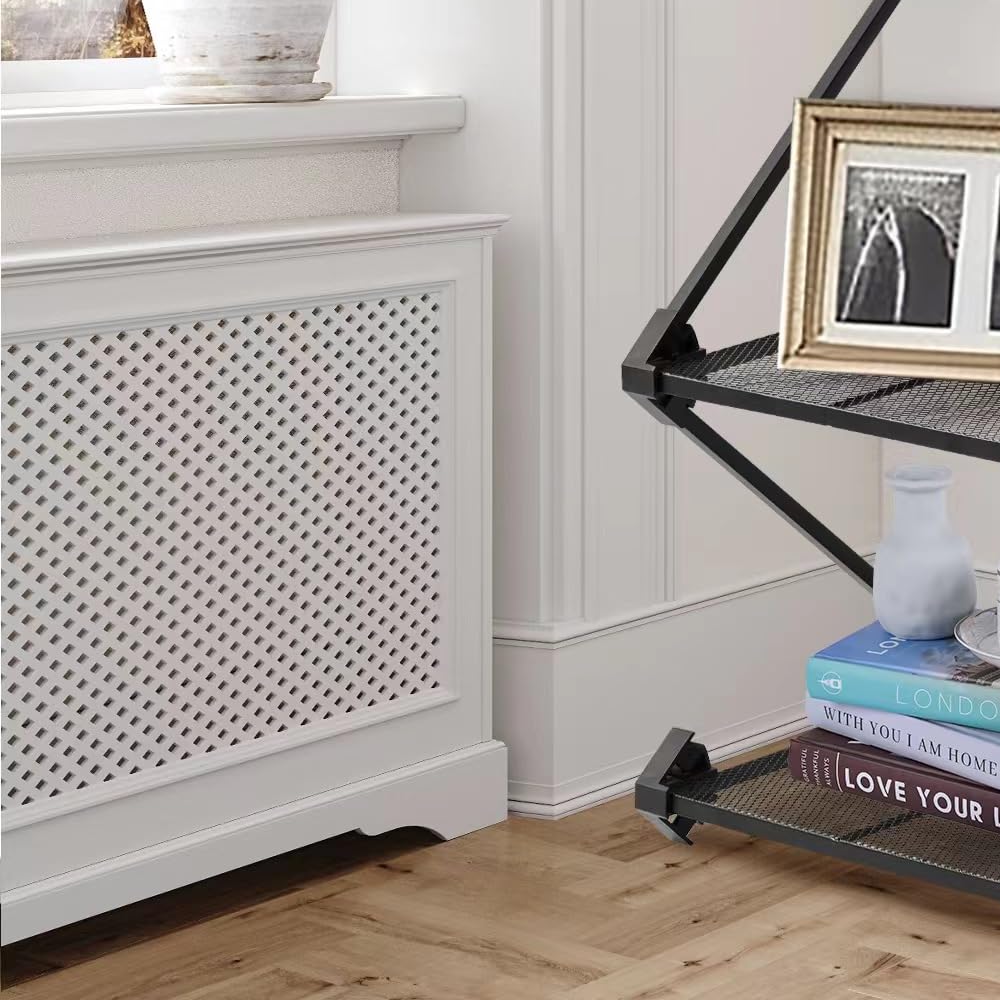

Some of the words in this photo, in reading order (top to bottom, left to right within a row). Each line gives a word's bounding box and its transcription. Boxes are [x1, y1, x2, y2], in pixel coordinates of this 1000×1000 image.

[824, 706, 863, 731] WITH
[870, 721, 901, 743] YOU
[907, 734, 912, 747] I
[918, 738, 941, 757] AM
[948, 747, 998, 777] HOME
[823, 757, 832, 786] ALWAYS
[844, 767, 907, 803] LOVE
[916, 786, 984, 823] YOUR
